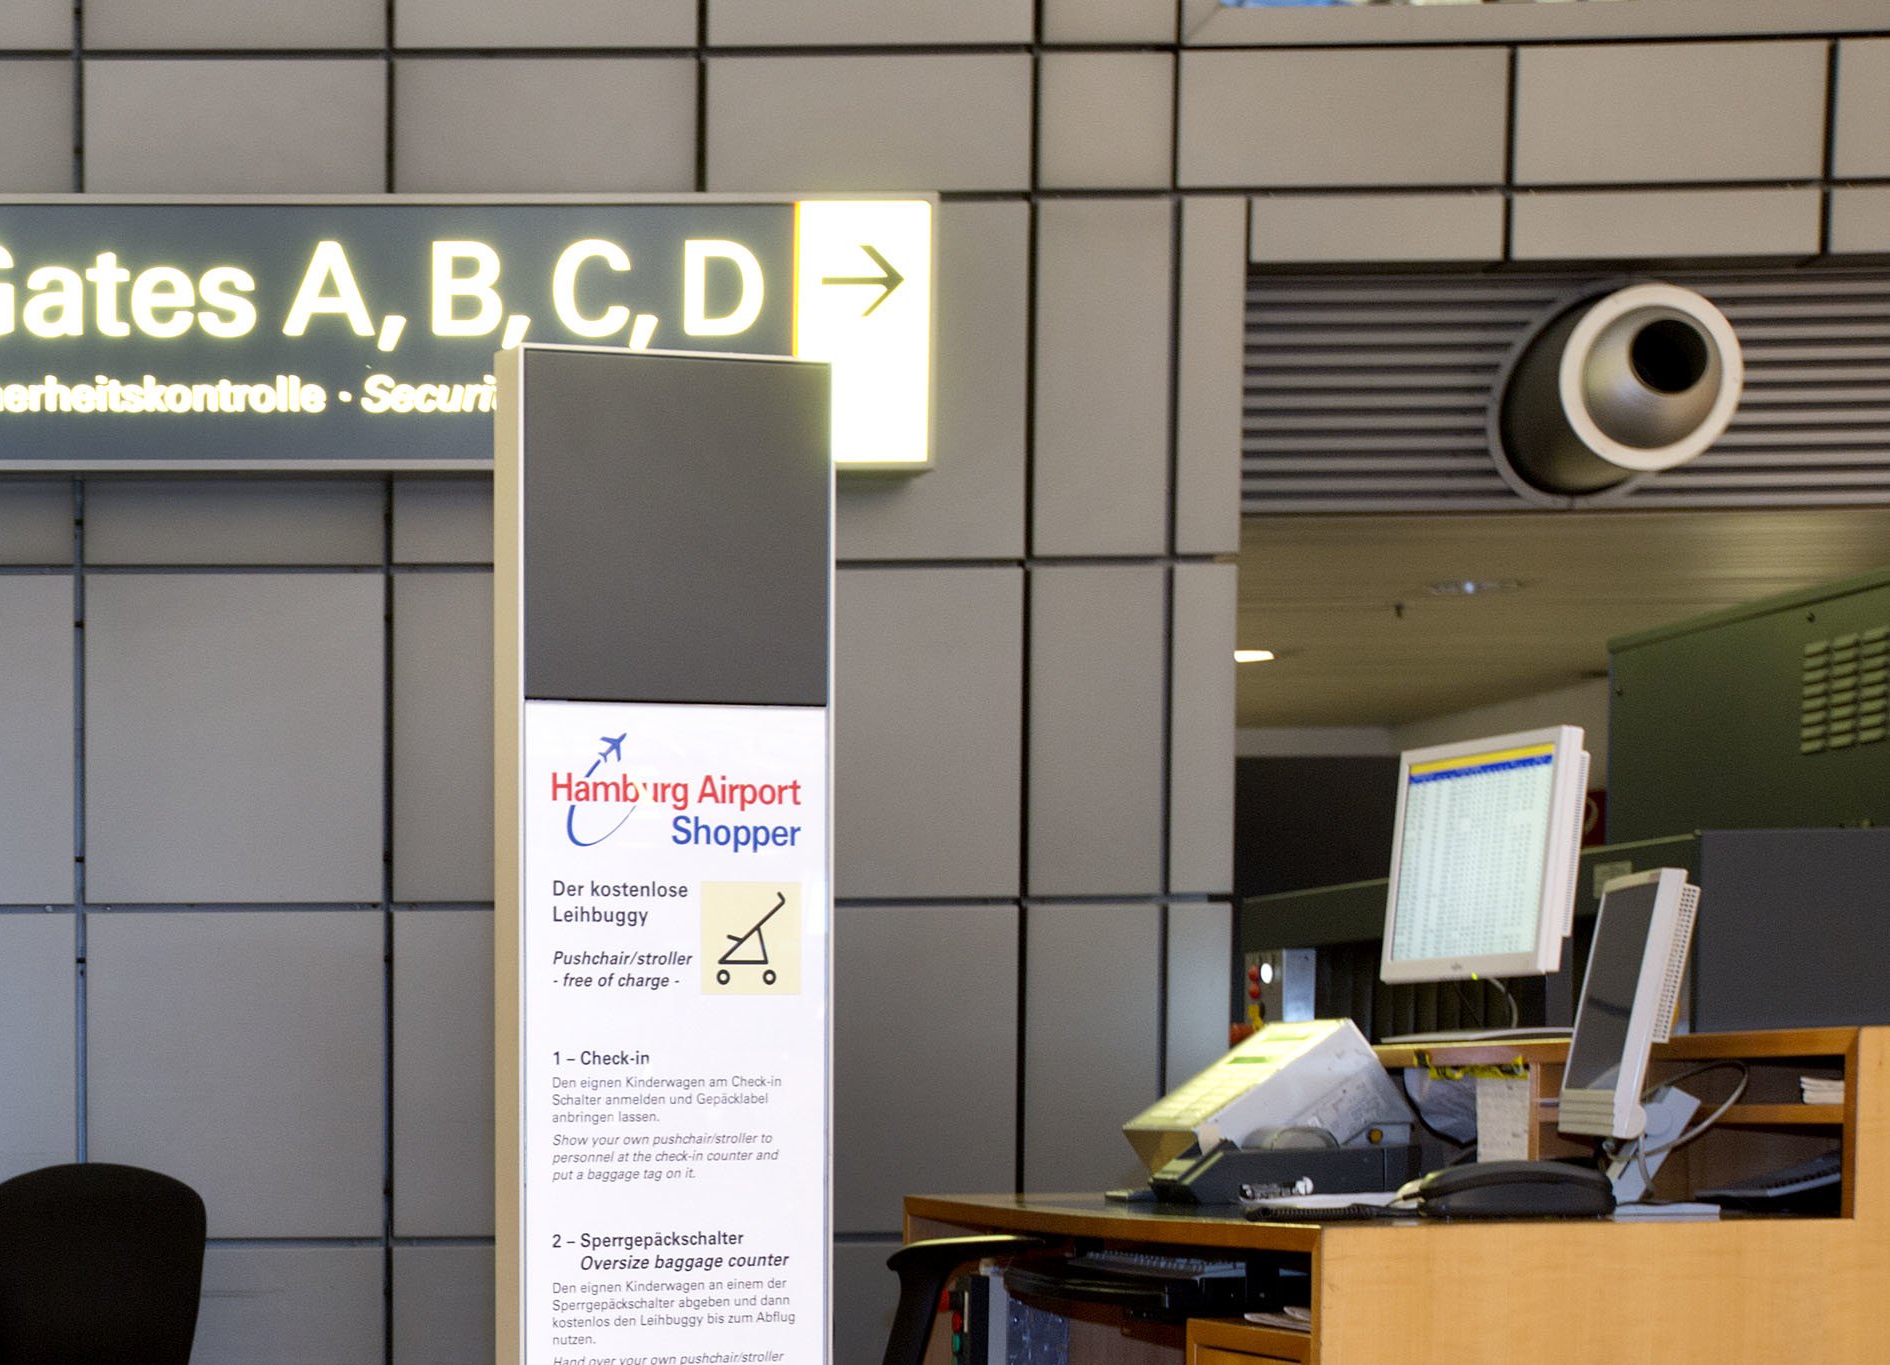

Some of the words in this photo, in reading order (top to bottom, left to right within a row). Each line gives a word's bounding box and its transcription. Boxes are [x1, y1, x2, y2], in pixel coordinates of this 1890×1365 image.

[682, 239, 766, 338] D
[360, 373, 497, 414] Securi
[697, 774, 802, 812] Airport
[671, 814, 802, 854] Shopper
[552, 879, 585, 897] Der
[590, 879, 689, 898] kostenlose
[552, 905, 649, 928] Leihbuggy
[552, 950, 694, 966] Pushchair/stroller
[562, 972, 593, 988] free
[597, 972, 615, 988] of
[617, 972, 670, 991] charge
[552, 1050, 560, 1066] 1
[580, 1049, 650, 1066] Check-in
[552, 1076, 577, 1089] Den
[579, 1076, 622, 1092] eignen
[625, 1076, 706, 1091] Kinderwagen
[708, 1078, 728, 1088] am
[731, 1075, 782, 1088] Check-in
[551, 1093, 602, 1106] Schalter
[605, 1093, 666, 1106] anmelden
[669, 1093, 693, 1105] und
[696, 1092, 769, 1107] Gepäcklabel
[551, 1110, 615, 1126] anbringen
[618, 1110, 661, 1123] lassen.
[552, 1133, 589, 1147] Show
[591, 1136, 621, 1148] your
[622, 1135, 650, 1146] own
[652, 1132, 759, 1148] pushchair/stroller
[760, 1133, 773, 1144] to
[551, 1150, 615, 1166] personnel
[616, 1152, 630, 1163] at
[632, 1150, 652, 1163] the
[654, 1149, 704, 1162] check-in
[706, 1151, 754, 1162] counter
[755, 1148, 780, 1161] and
[551, 1170, 574, 1183] put
[575, 1171, 584, 1181] a
[586, 1168, 641, 1183] baggage
[643, 1169, 663, 1182] tag
[665, 1169, 682, 1180] on
[684, 1167, 696, 1179] it.
[552, 1233, 562, 1249] 2
[580, 1230, 745, 1252] Sperrgepäckschalter
[580, 1254, 650, 1271] Oversize
[654, 1254, 724, 1273] baggage
[727, 1253, 790, 1268] counter
[552, 1281, 577, 1294] Den
[580, 1281, 622, 1296] eignen
[625, 1280, 705, 1294] Kinderwagen
[708, 1281, 724, 1291] an
[726, 1278, 764, 1291] einem
[766, 1277, 788, 1289] der
[551, 1297, 676, 1314] Sperrgepäckschalter
[678, 1295, 731, 1311] abgeben
[733, 1294, 757, 1307] und
[760, 1294, 790, 1306] dann
[552, 1316, 611, 1329] kostenlos
[613, 1315, 637, 1327] den
[640, 1313, 704, 1328] Leihbuggy
[706, 1312, 725, 1325] bis
[727, 1314, 753, 1324] zum
[755, 1310, 796, 1326] Abflug
[552, 1335, 597, 1346] nutzen.
[649, 1355, 677, 1365] own
